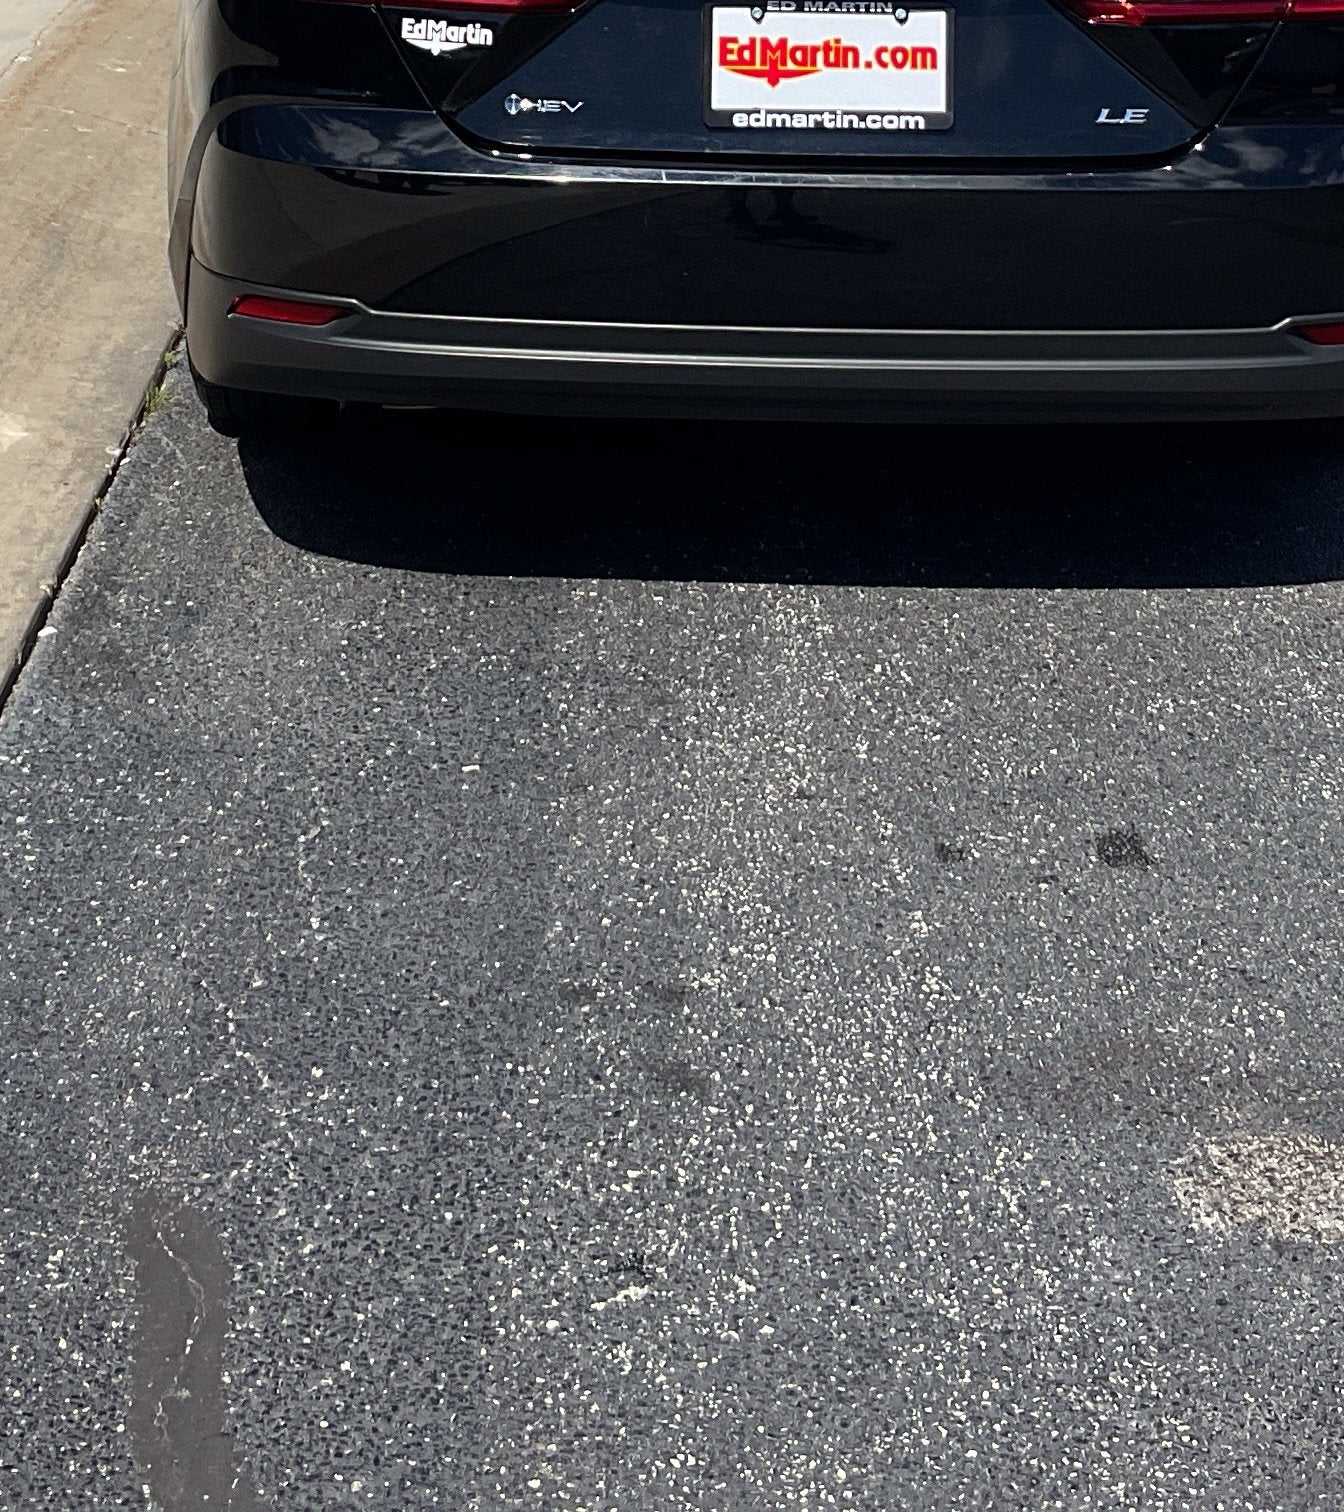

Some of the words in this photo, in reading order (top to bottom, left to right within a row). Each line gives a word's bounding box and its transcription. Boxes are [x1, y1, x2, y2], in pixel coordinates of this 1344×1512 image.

[766, 0, 797, 12] ED
[803, 0, 894, 13] MARTIN
[401, 17, 494, 48] EdMartin
[732, 109, 926, 130] edmartin.com
[1095, 107, 1150, 125] LE
